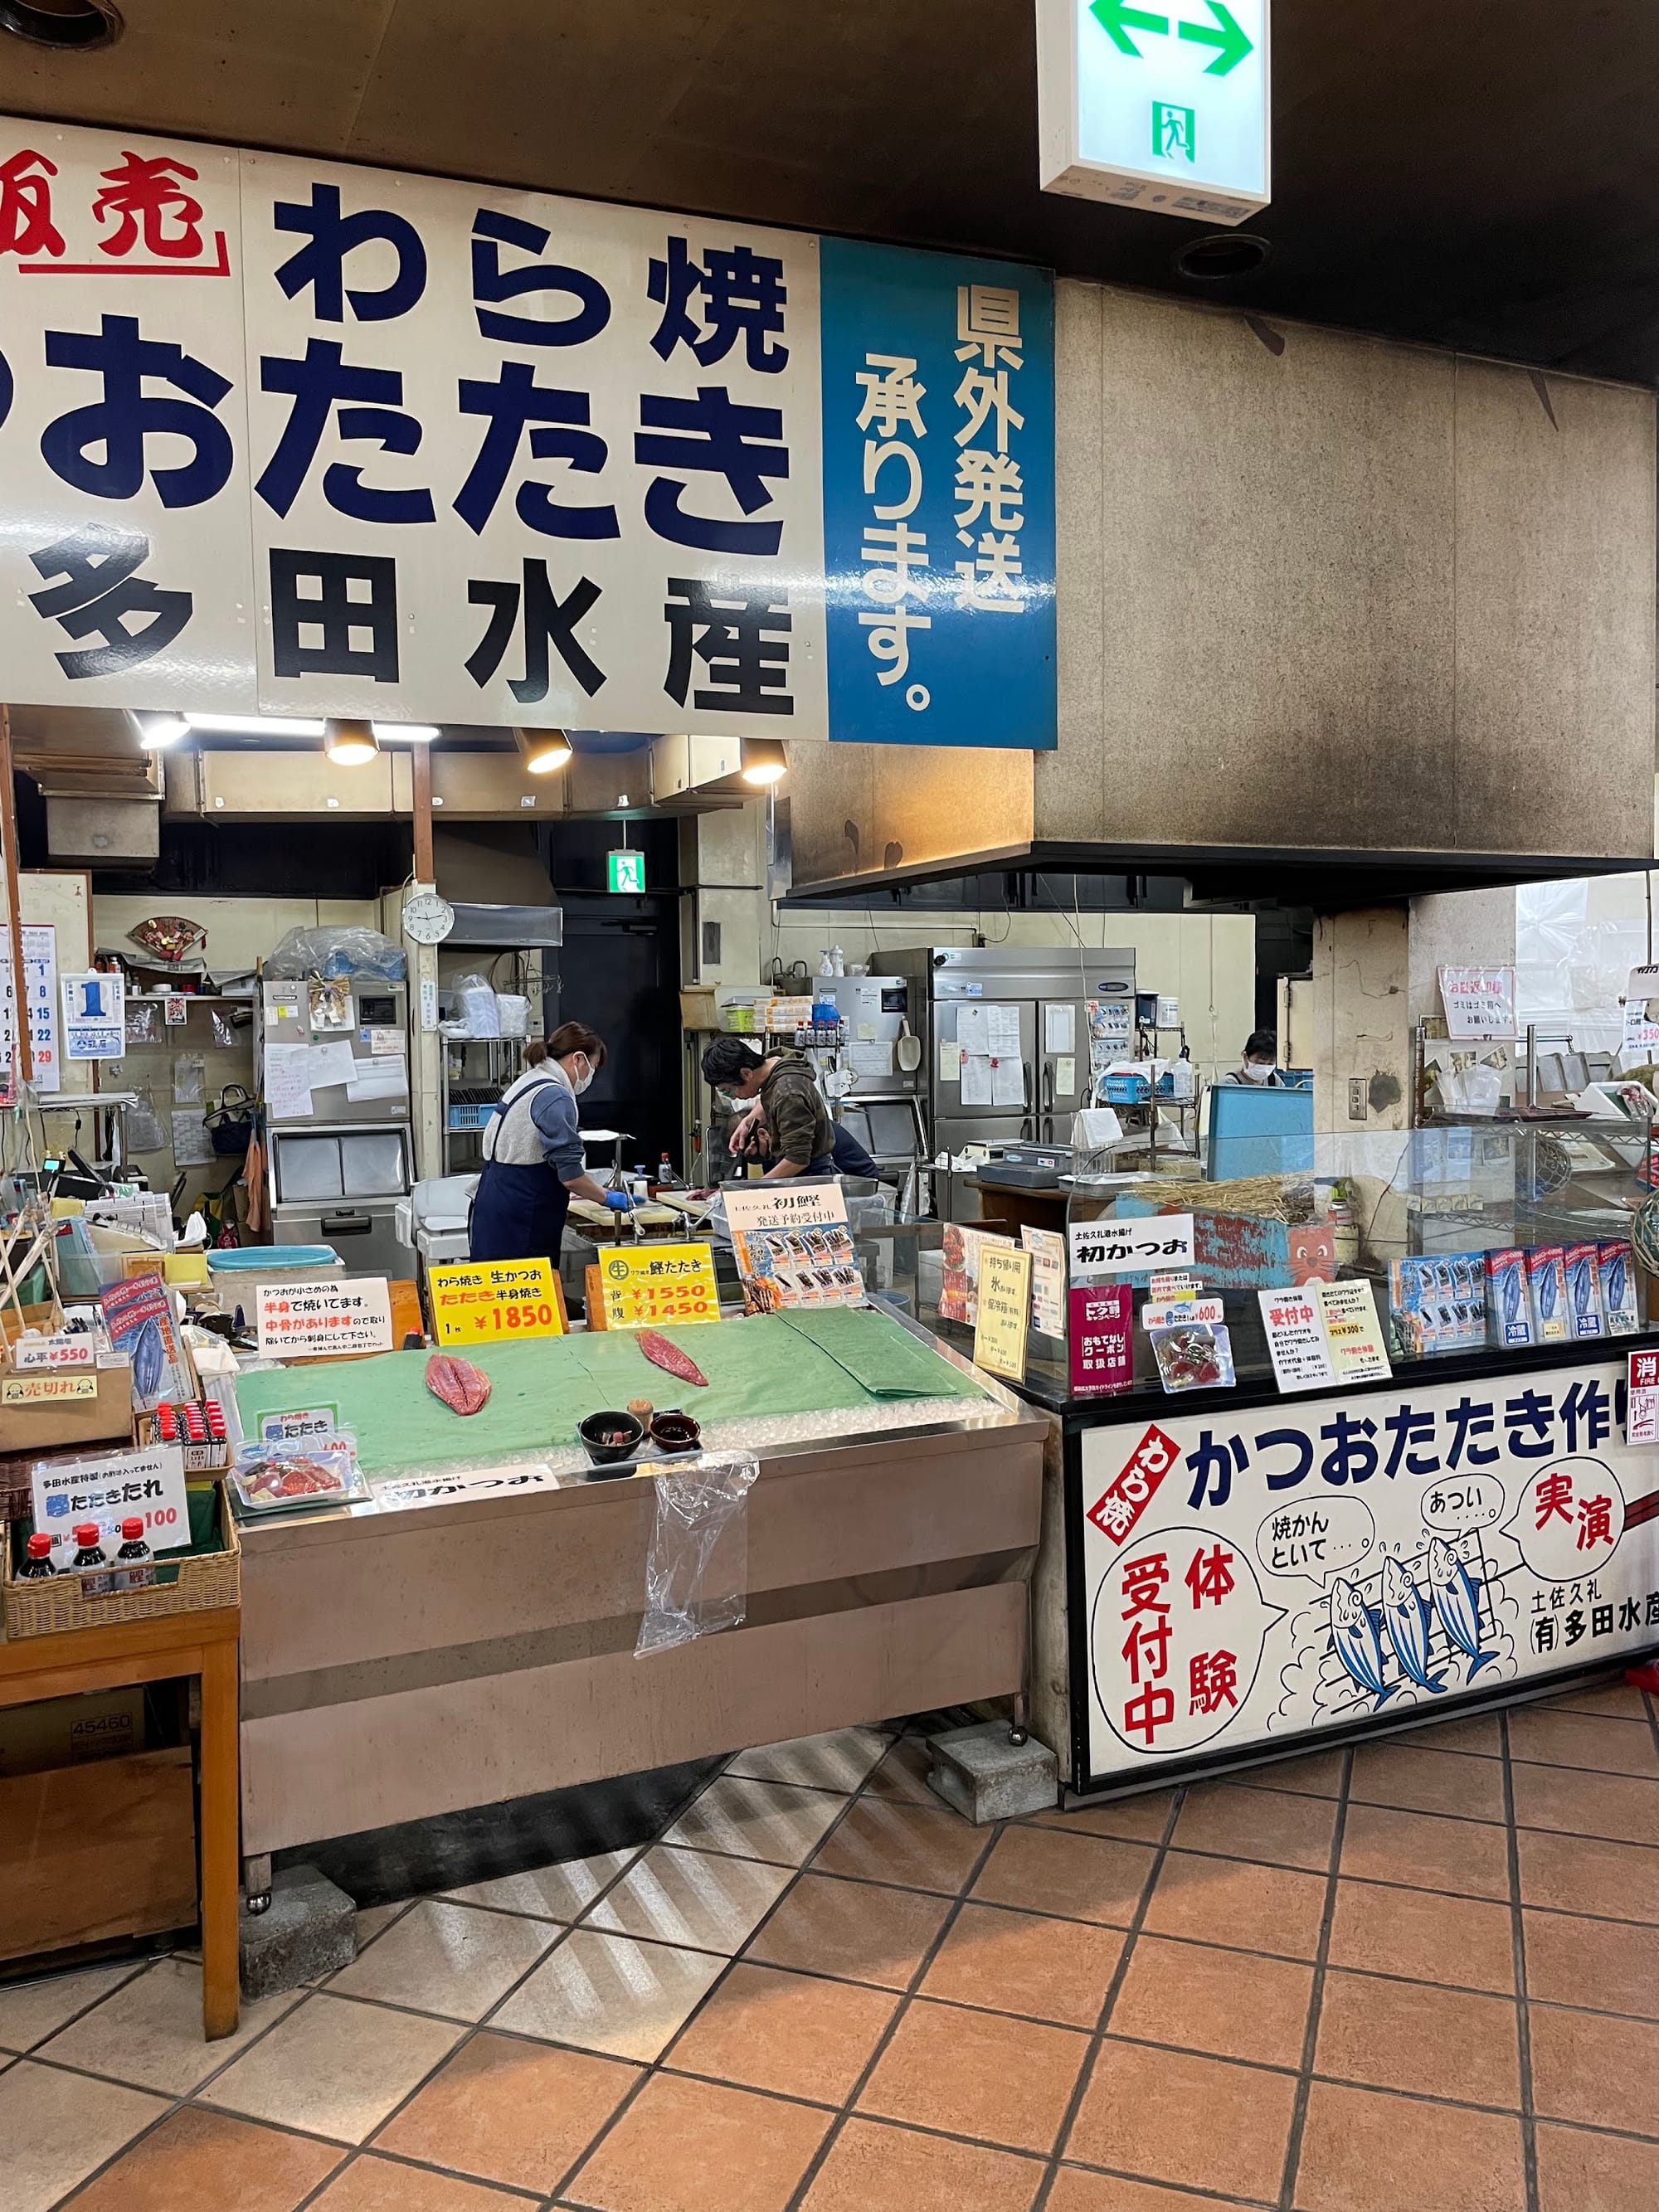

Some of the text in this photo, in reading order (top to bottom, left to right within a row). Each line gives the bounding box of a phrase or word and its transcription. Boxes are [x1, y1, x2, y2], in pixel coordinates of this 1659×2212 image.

[274, 183, 789, 373] わら焼
[954, 284, 1024, 614] 県外発送
[855, 353, 931, 712] 承ります。
[29, 523, 794, 716] 多田水産
[80, 982, 106, 1017] 1
[36, 1008, 50, 1019] 15
[37, 1030, 51, 1041] 22
[38, 1051, 51, 1062] 29
[757, 1211, 834, 1227] 発送予約受付中
[1077, 1239, 1187, 1262] 初かつお
[437, 1269, 542, 1287] わら焼き 生かつお
[440, 1287, 542, 1305] たたき半身焼き
[632, 1285, 705, 1300] ¥1550
[264, 1296, 369, 1314] 半身で焼いてます。
[635, 1301, 708, 1316] ¥1450
[265, 1315, 385, 1331] 中骨がありますので取り
[474, 1304, 552, 1330] ¥1850
[1269, 1305, 1313, 1326] 受付中
[1083, 1333, 1123, 1346] おもてなし
[24, 1352, 47, 1363] 心平
[50, 1348, 88, 1361] ¥550
[1084, 1344, 1124, 1356] クーポン
[1082, 1355, 1126, 1369] 取扱店舗
[26, 1381, 75, 1397] 売切れ
[1640, 1378, 1656, 1386] FIRE
[1096, 1436, 1169, 1536] わら焼
[1430, 1486, 1482, 1514] あつい
[145, 1507, 177, 1528] 100
[1535, 1472, 1614, 1551] 実演
[1272, 1511, 1329, 1542] 焼かん
[1530, 1578, 1602, 1614] 土佐久礼
[1120, 1553, 1175, 1745] 受付中
[73, 1715, 130, 1734] 45460
